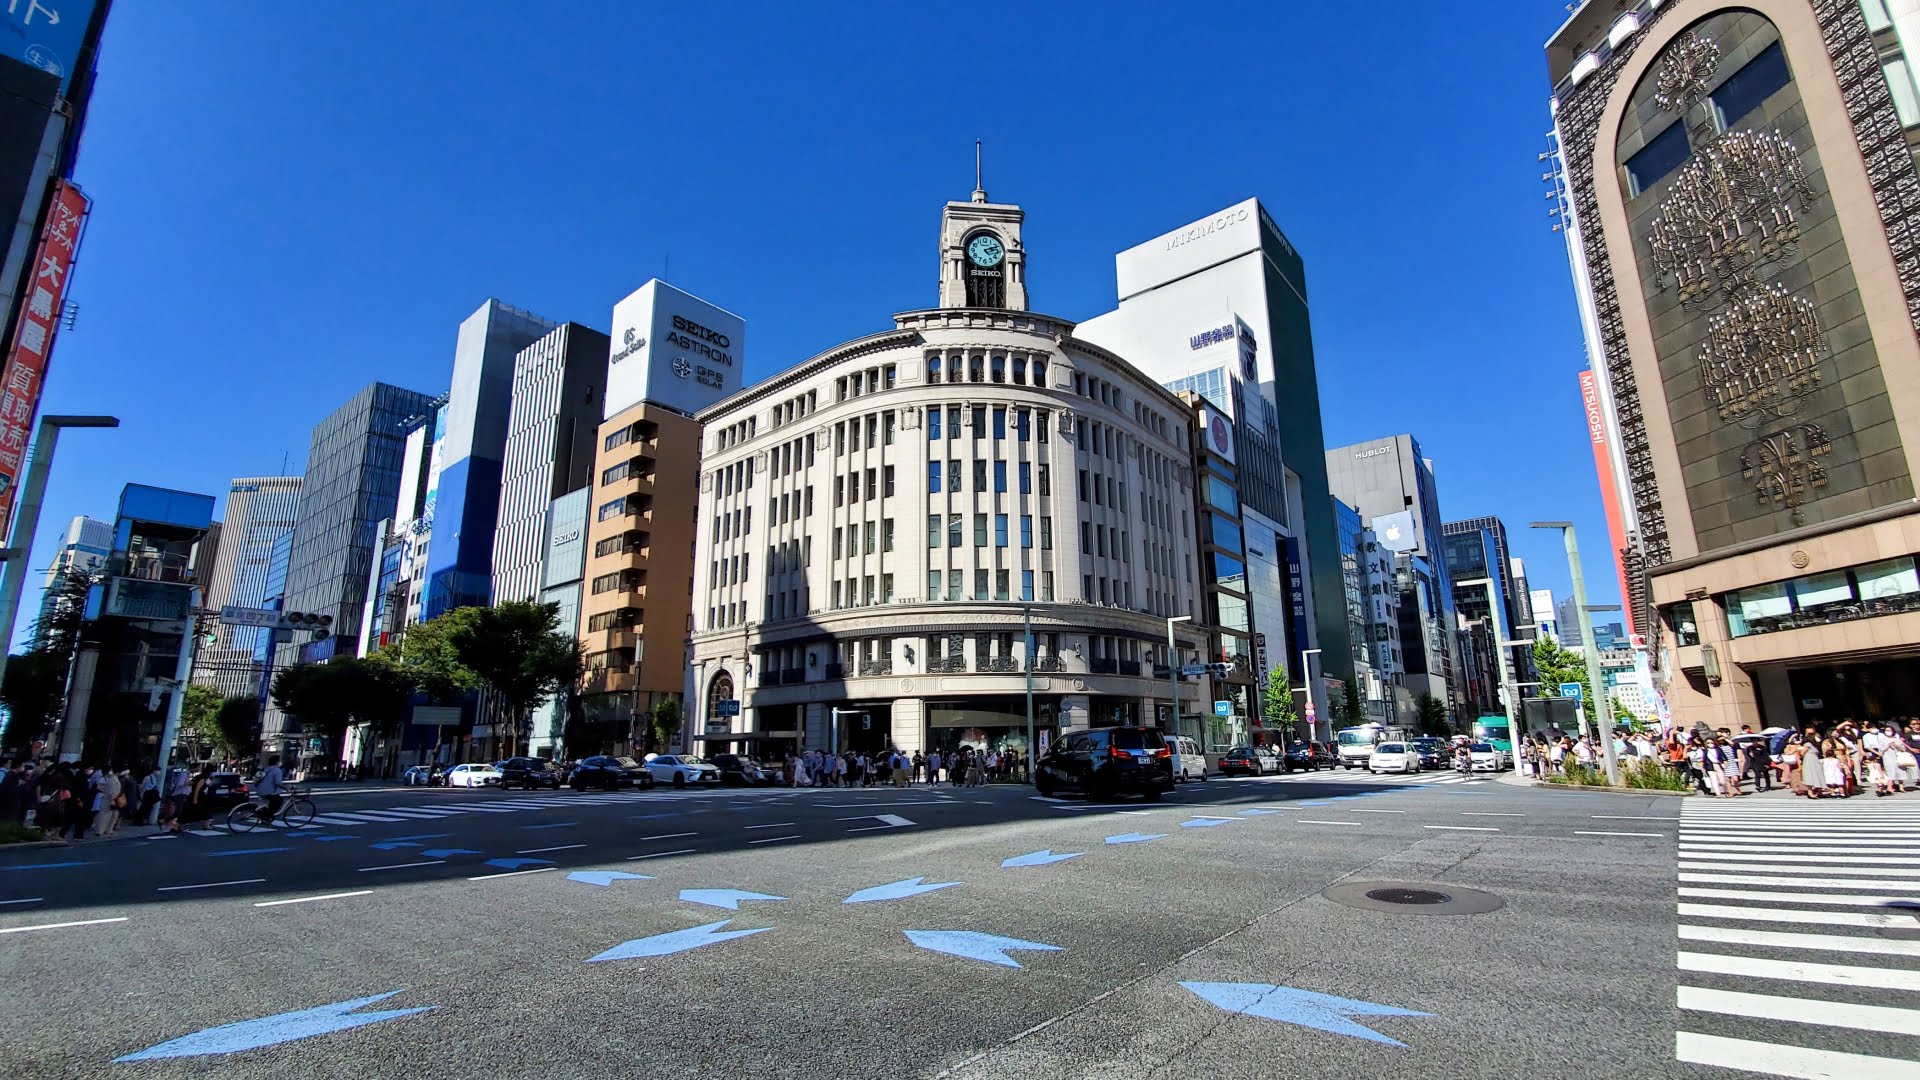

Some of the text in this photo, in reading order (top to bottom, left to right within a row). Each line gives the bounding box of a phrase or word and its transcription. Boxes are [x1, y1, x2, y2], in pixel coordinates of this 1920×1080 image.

[1166, 208, 1249, 251] MIKIMOTO
[1260, 209, 1293, 256] MIKIMOTO
[970, 269, 1001, 277] SEIKO
[20, 256, 64, 355] 大黒屋
[672, 315, 730, 348] SEIKO
[1190, 324, 1235, 350] 山野楽器
[666, 331, 732, 367] ASTRON
[696, 365, 724, 383] GPS
[696, 379, 723, 390] SOLAR
[1582, 375, 1605, 444] MITSUKOSHI
[1355, 446, 1392, 460] HUBLOT
[553, 529, 579, 546] SEIKO
[1367, 541, 1382, 595] 教文館
[1289, 563, 1304, 616] 山野楽器
[1376, 626, 1387, 639] 本
